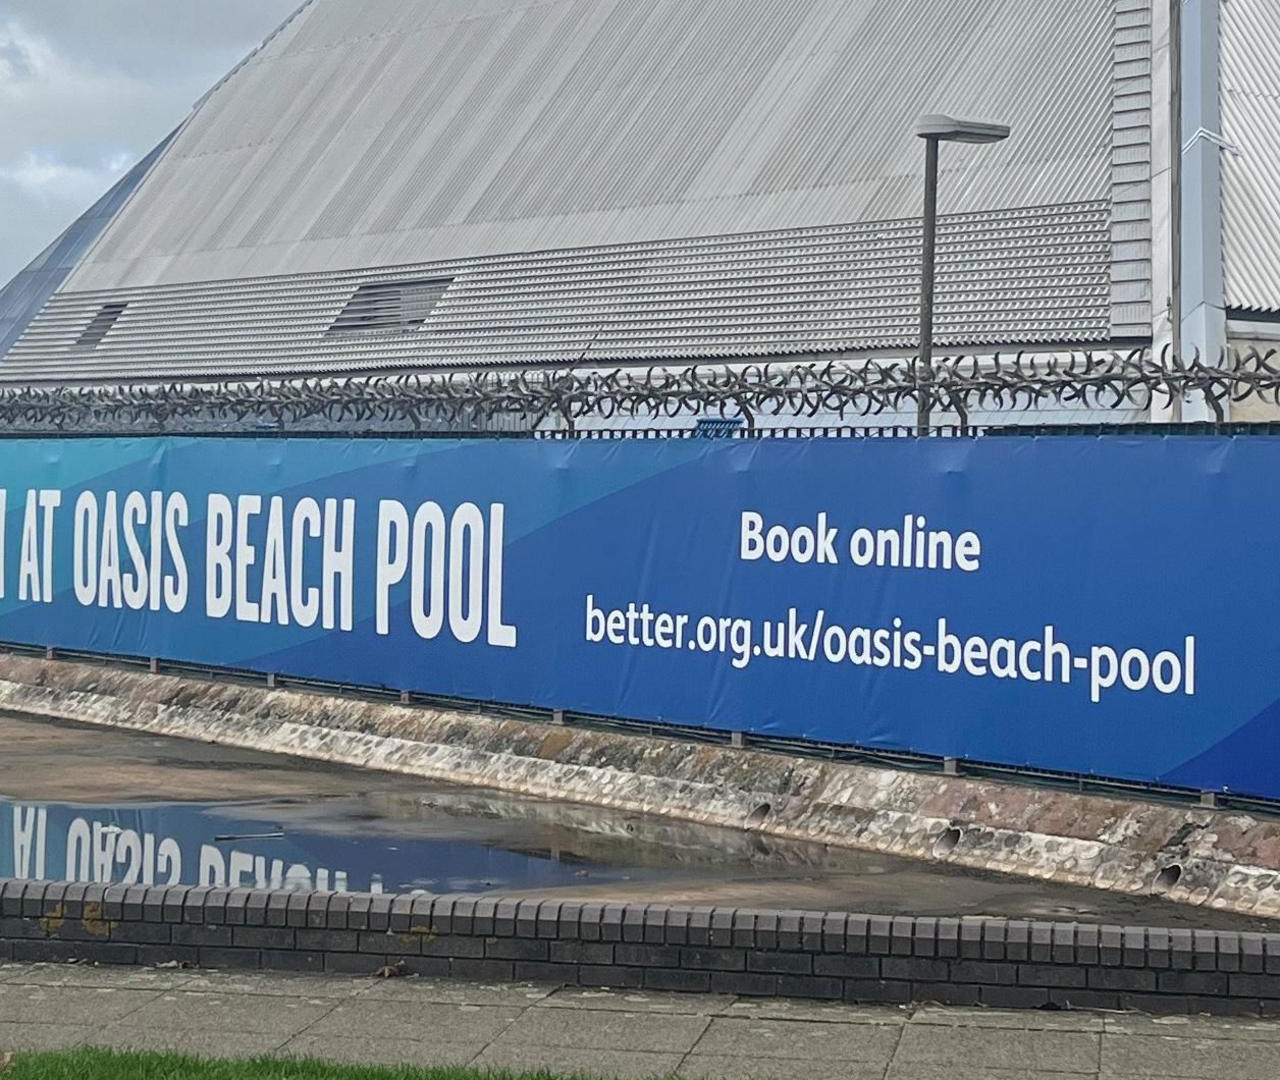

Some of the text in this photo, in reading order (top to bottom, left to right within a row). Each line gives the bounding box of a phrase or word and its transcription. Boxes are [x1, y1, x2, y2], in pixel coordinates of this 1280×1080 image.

[18, 488, 62, 603] AT
[73, 489, 189, 613] OASIS
[205, 492, 356, 632] BEACH
[375, 499, 517, 648] POOL
[740, 511, 981, 572] Book online
[584, 594, 1195, 703] better.org.uk/oasis-beach-pool
